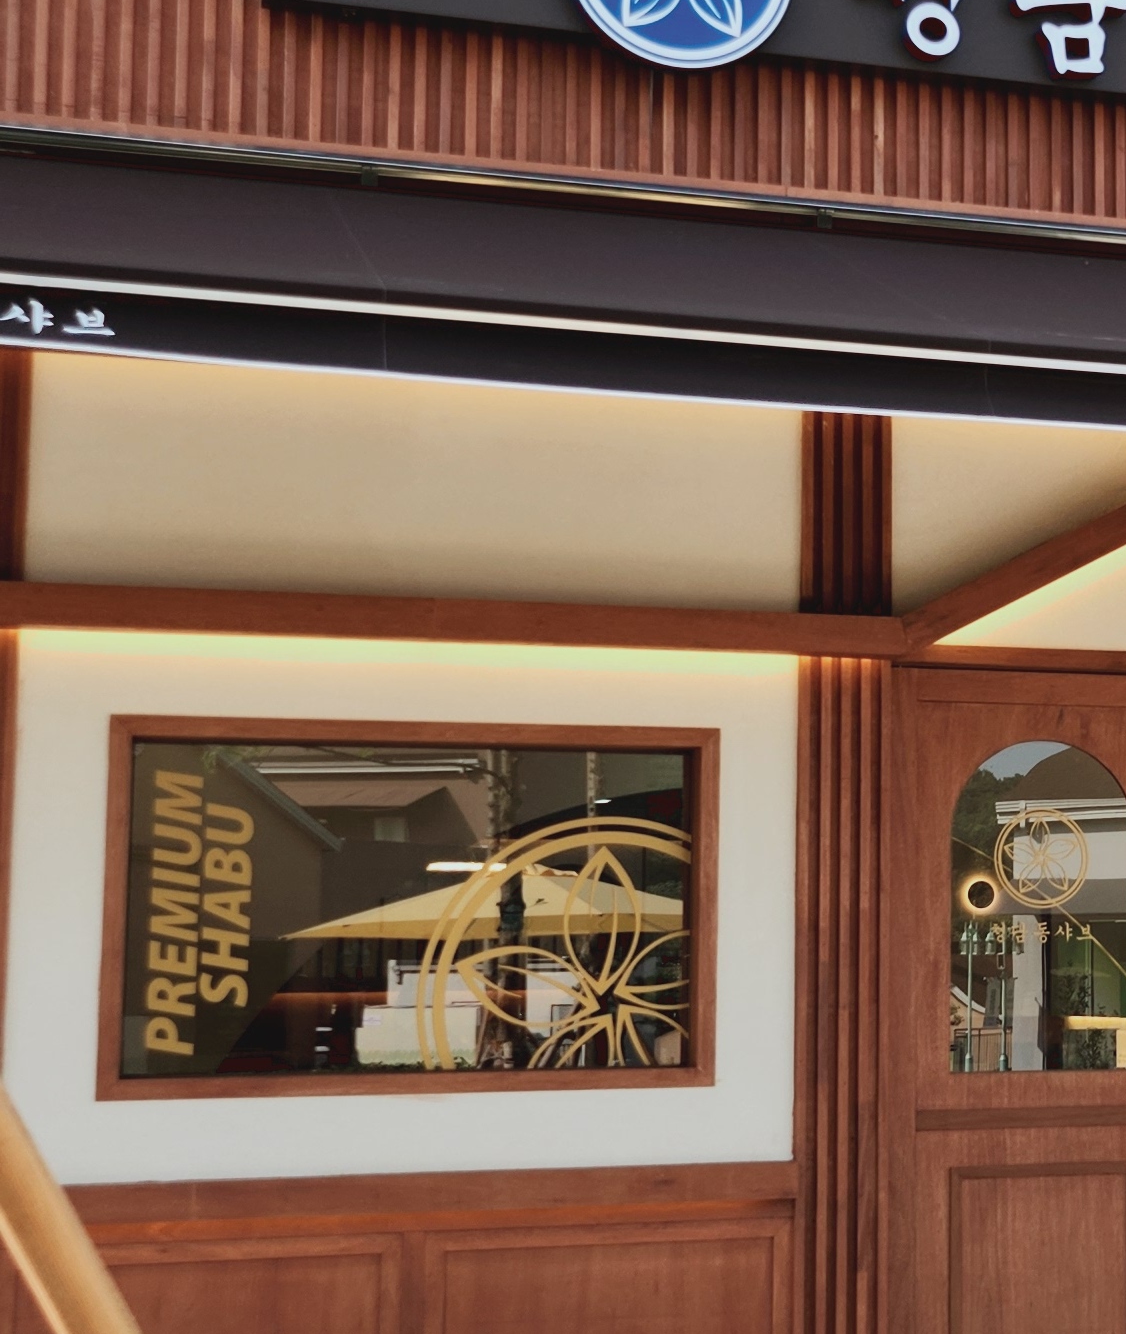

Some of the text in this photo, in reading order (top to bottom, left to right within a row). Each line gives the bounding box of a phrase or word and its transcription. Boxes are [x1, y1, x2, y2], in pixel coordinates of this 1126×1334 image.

[146, 770, 204, 1056] PREMIUM
[200, 803, 255, 1008] SHABU
[991, 921, 1093, 943] 청담동샤브
